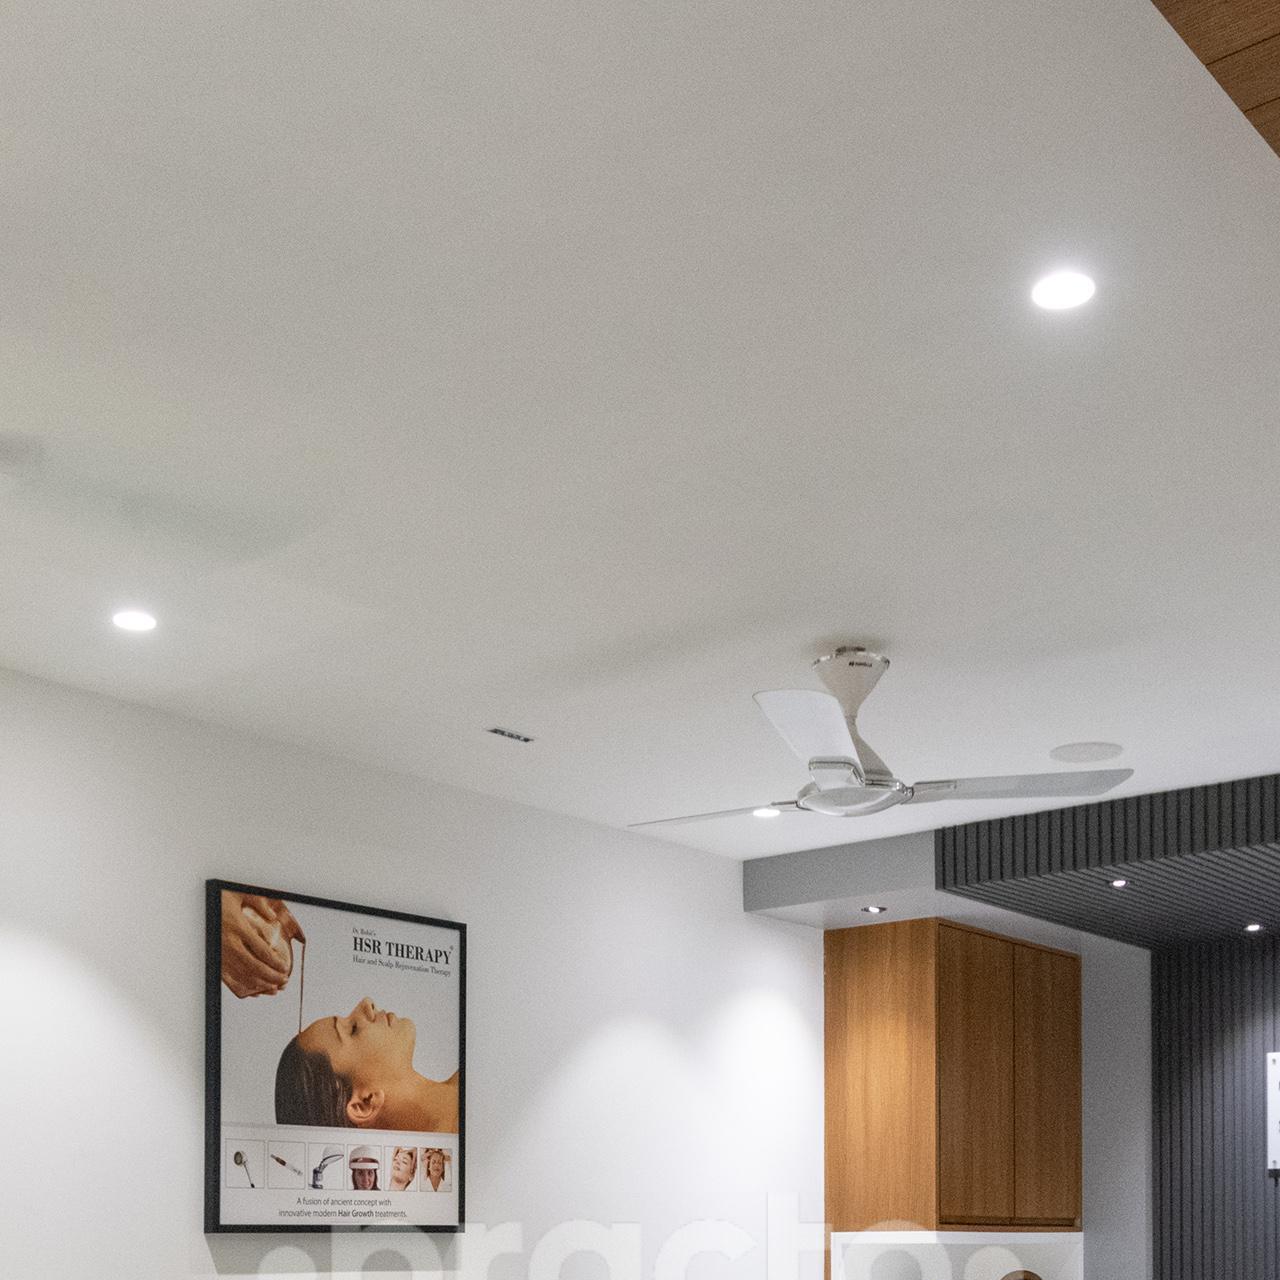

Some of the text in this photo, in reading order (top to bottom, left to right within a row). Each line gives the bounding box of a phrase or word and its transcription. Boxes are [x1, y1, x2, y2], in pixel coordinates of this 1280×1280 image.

[353, 936, 451, 965] HSR THERAPY
[302, 1197, 322, 1205] fusion
[323, 1197, 330, 1205] of
[330, 1198, 353, 1206] ancient
[353, 1199, 378, 1207] concept
[378, 1198, 392, 1206] with
[279, 1209, 311, 1217] innovative
[312, 1209, 337, 1217] modern
[338, 1209, 351, 1217] Hair
[351, 1209, 374, 1218] Growth
